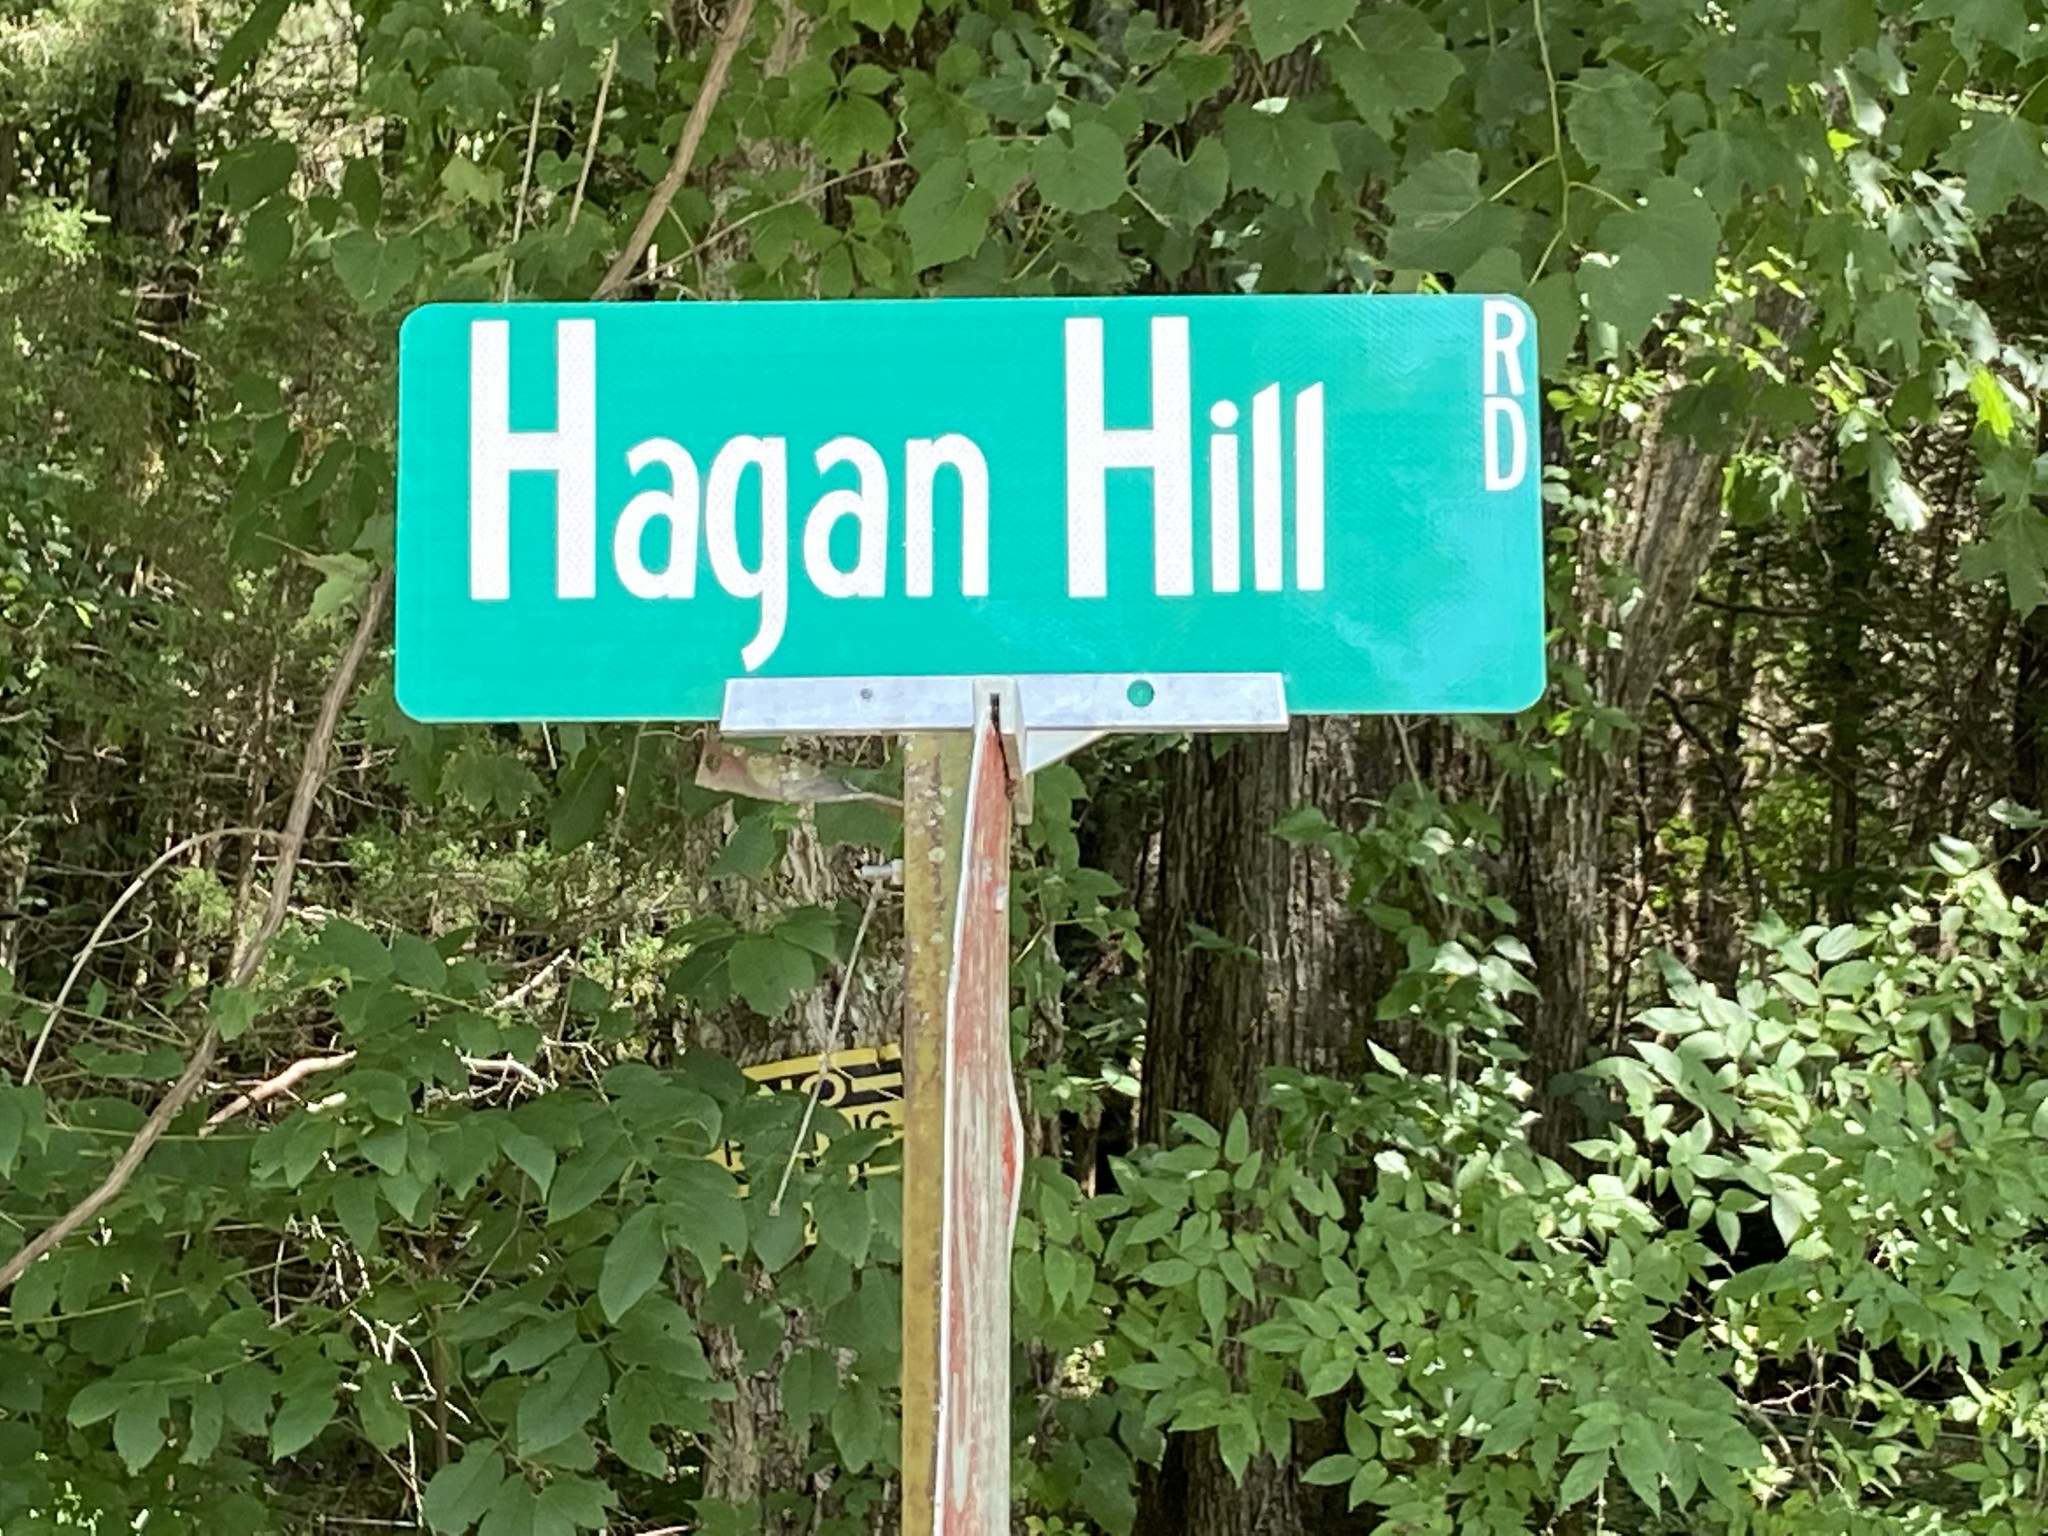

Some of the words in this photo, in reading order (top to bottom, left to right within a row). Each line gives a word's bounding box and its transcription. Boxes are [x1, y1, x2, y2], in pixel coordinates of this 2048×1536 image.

[470, 318, 989, 672] Hagan
[1064, 316, 1326, 598] Hill
[1482, 299, 1528, 492] RD
